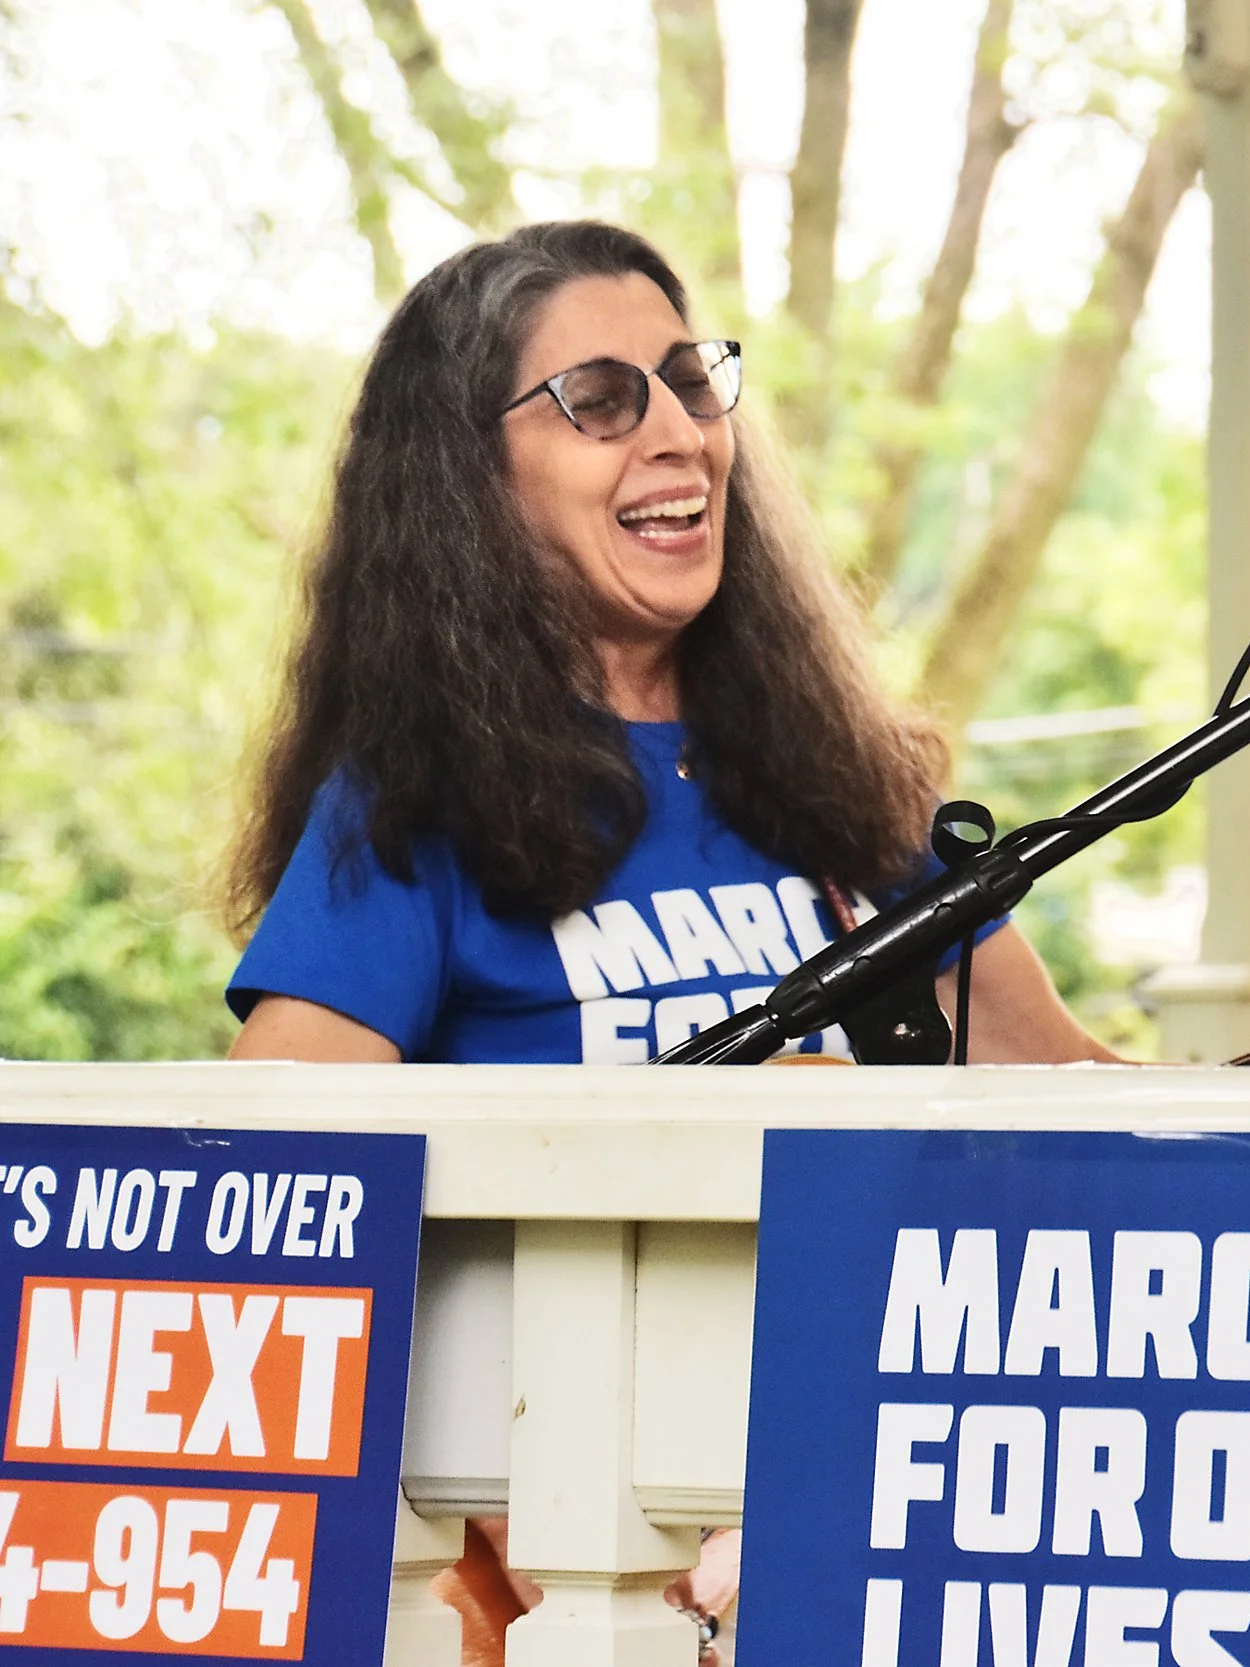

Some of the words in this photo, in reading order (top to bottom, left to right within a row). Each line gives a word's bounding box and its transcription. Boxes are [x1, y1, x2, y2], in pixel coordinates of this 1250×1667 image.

[551, 876, 880, 1001] MARC
[0, 1165, 57, 1249] 'S
[66, 1167, 197, 1253] NOT
[205, 1171, 364, 1259] OVER
[15, 1287, 365, 1461] NEXT
[869, 1402, 1148, 1558] FOR
